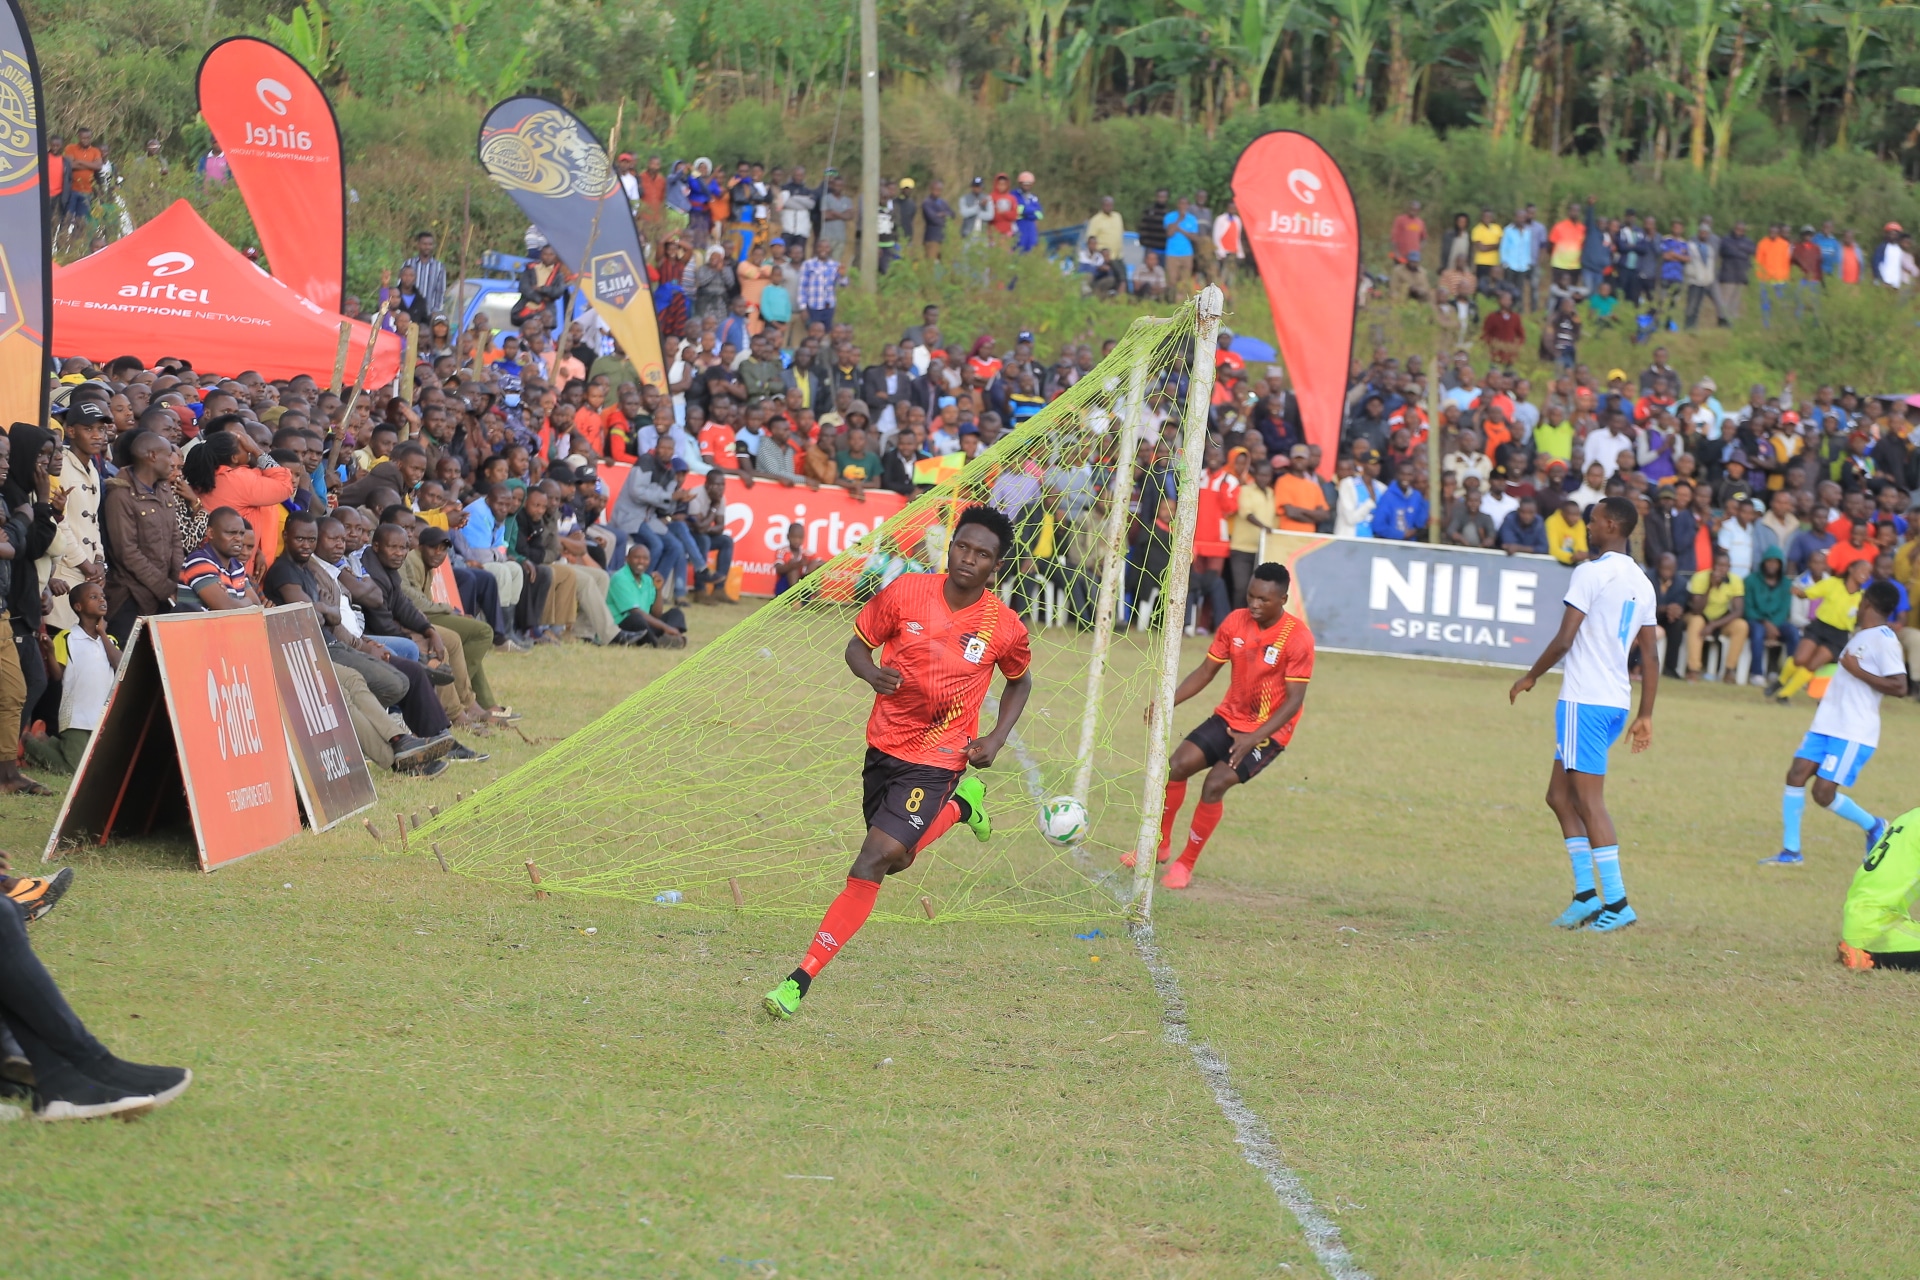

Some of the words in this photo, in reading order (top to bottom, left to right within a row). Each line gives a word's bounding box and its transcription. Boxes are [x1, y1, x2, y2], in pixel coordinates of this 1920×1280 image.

[117, 281, 210, 304] airtel
[53, 298, 81, 308] THE
[84, 301, 192, 318] SMARTPHONE
[194, 311, 272, 327] NETWORK
[1369, 556, 1538, 625] NILE
[1390, 617, 1512, 648] SPECIAL
[281, 638, 339, 737] NILE
[221, 656, 264, 758] airtel
[905, 787, 925, 813] 8
